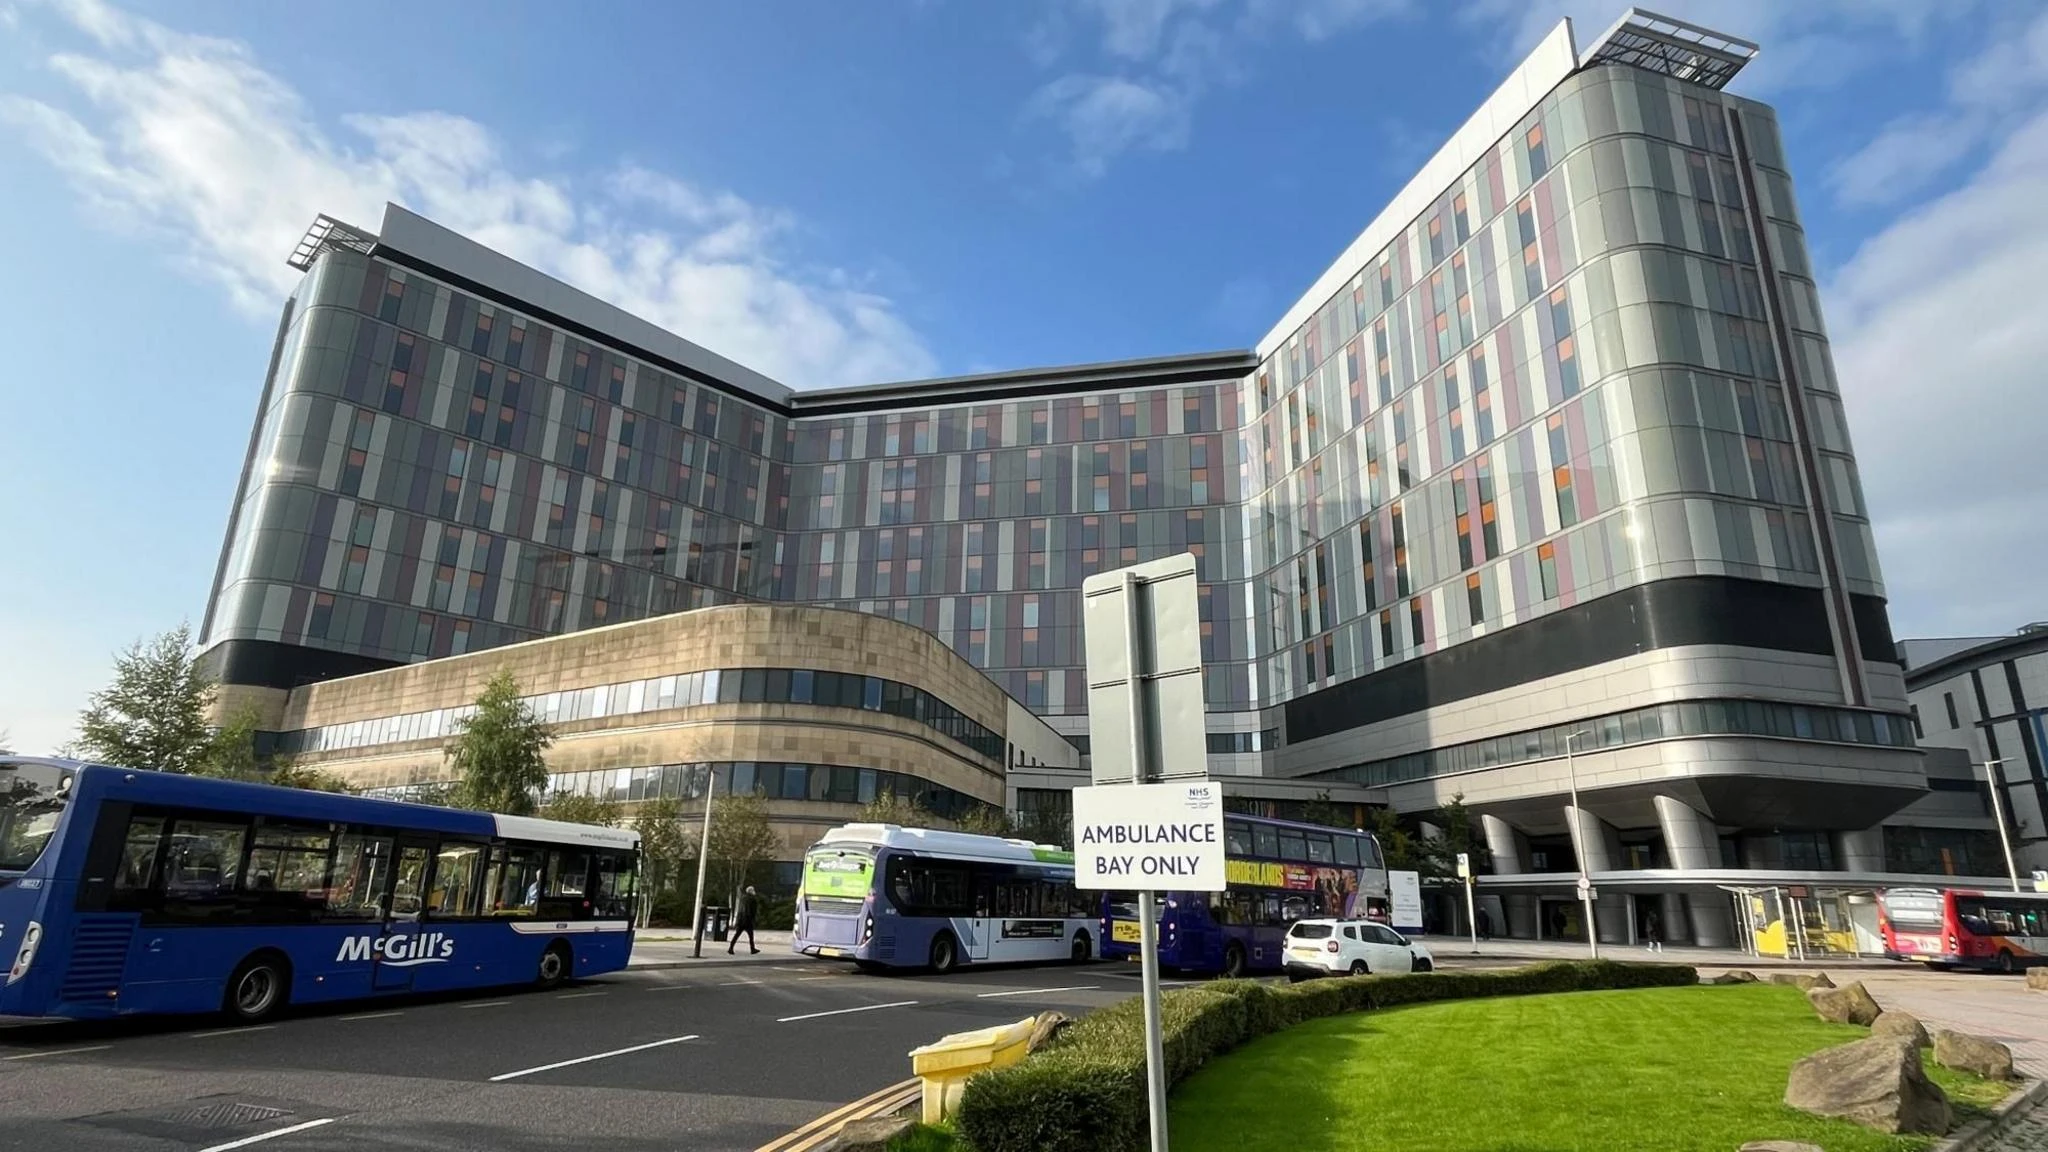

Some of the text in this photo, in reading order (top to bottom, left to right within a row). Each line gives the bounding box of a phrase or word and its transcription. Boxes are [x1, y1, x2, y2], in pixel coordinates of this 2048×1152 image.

[1190, 788, 1209, 796] NHS
[1082, 823, 1216, 844] AMBULANCE
[1096, 856, 1200, 875] BAY ONLY
[1226, 860, 1284, 887] ORDERLANDS
[336, 932, 454, 961] McGill's
